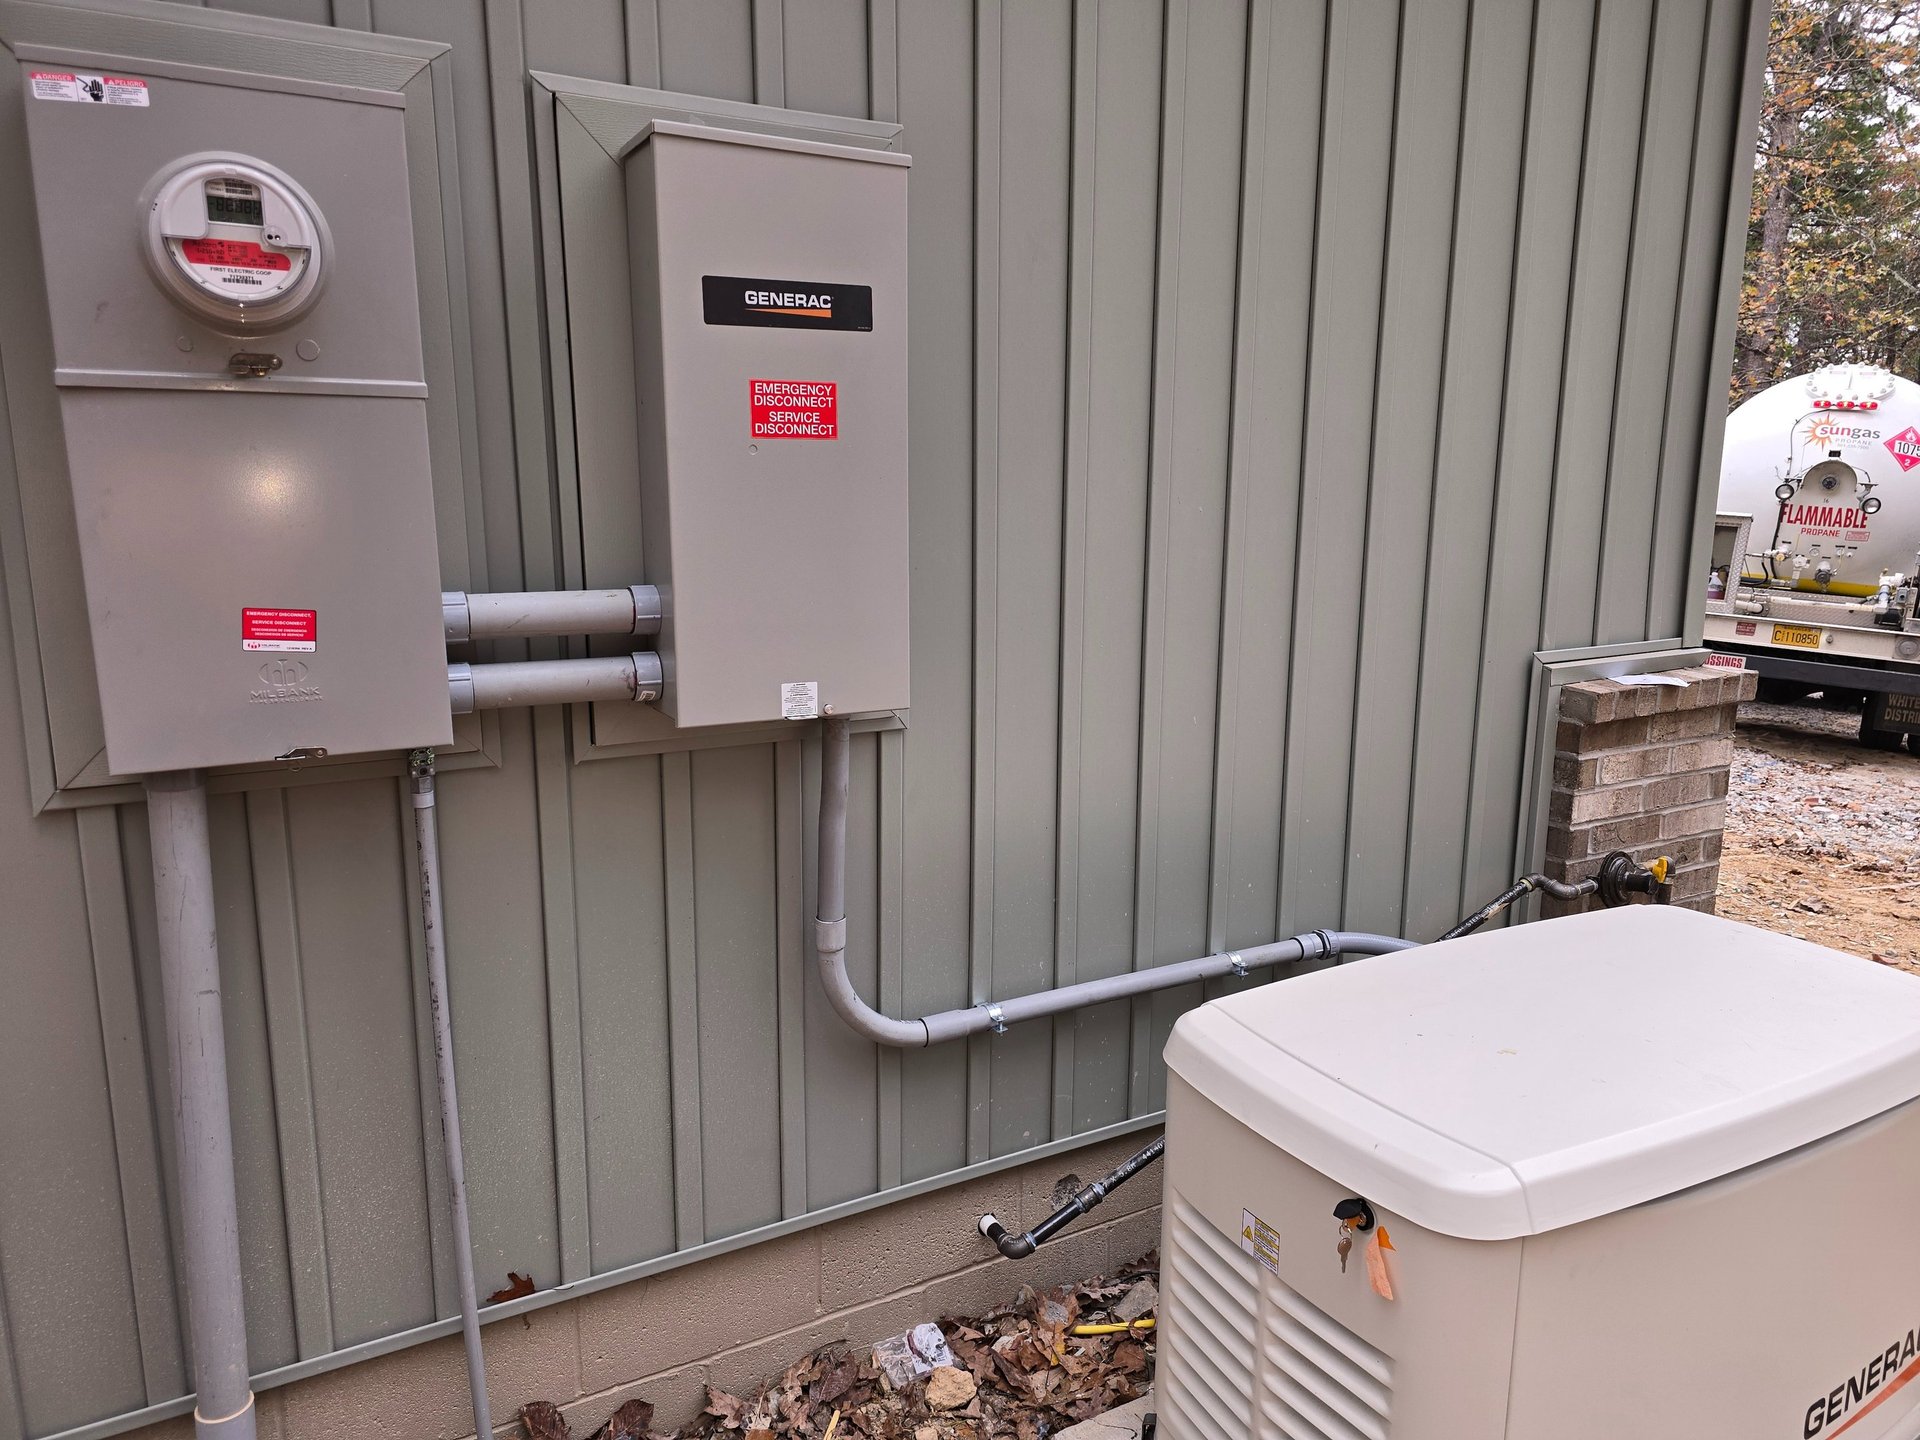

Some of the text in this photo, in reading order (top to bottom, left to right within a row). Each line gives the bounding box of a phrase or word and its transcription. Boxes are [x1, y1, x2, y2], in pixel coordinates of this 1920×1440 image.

[42, 73, 72, 81] DANGER
[114, 79, 144, 87] PELIGRO
[744, 290, 832, 308] GENERAC
[755, 382, 833, 396] EMERGENCY
[754, 395, 834, 408] DISCONNECT
[769, 411, 820, 423] SERVICE
[755, 423, 834, 435] DISCONNECT
[1820, 426, 1881, 439] sungas
[1904, 458, 1911, 467] 2
[1780, 503, 1868, 529] FLAMMABLE
[1801, 527, 1840, 537] PROPANE
[250, 686, 320, 700] MILBANK
[1884, 707, 1920, 724] DISTRI
[1803, 1324, 1920, 1440] GENERA
